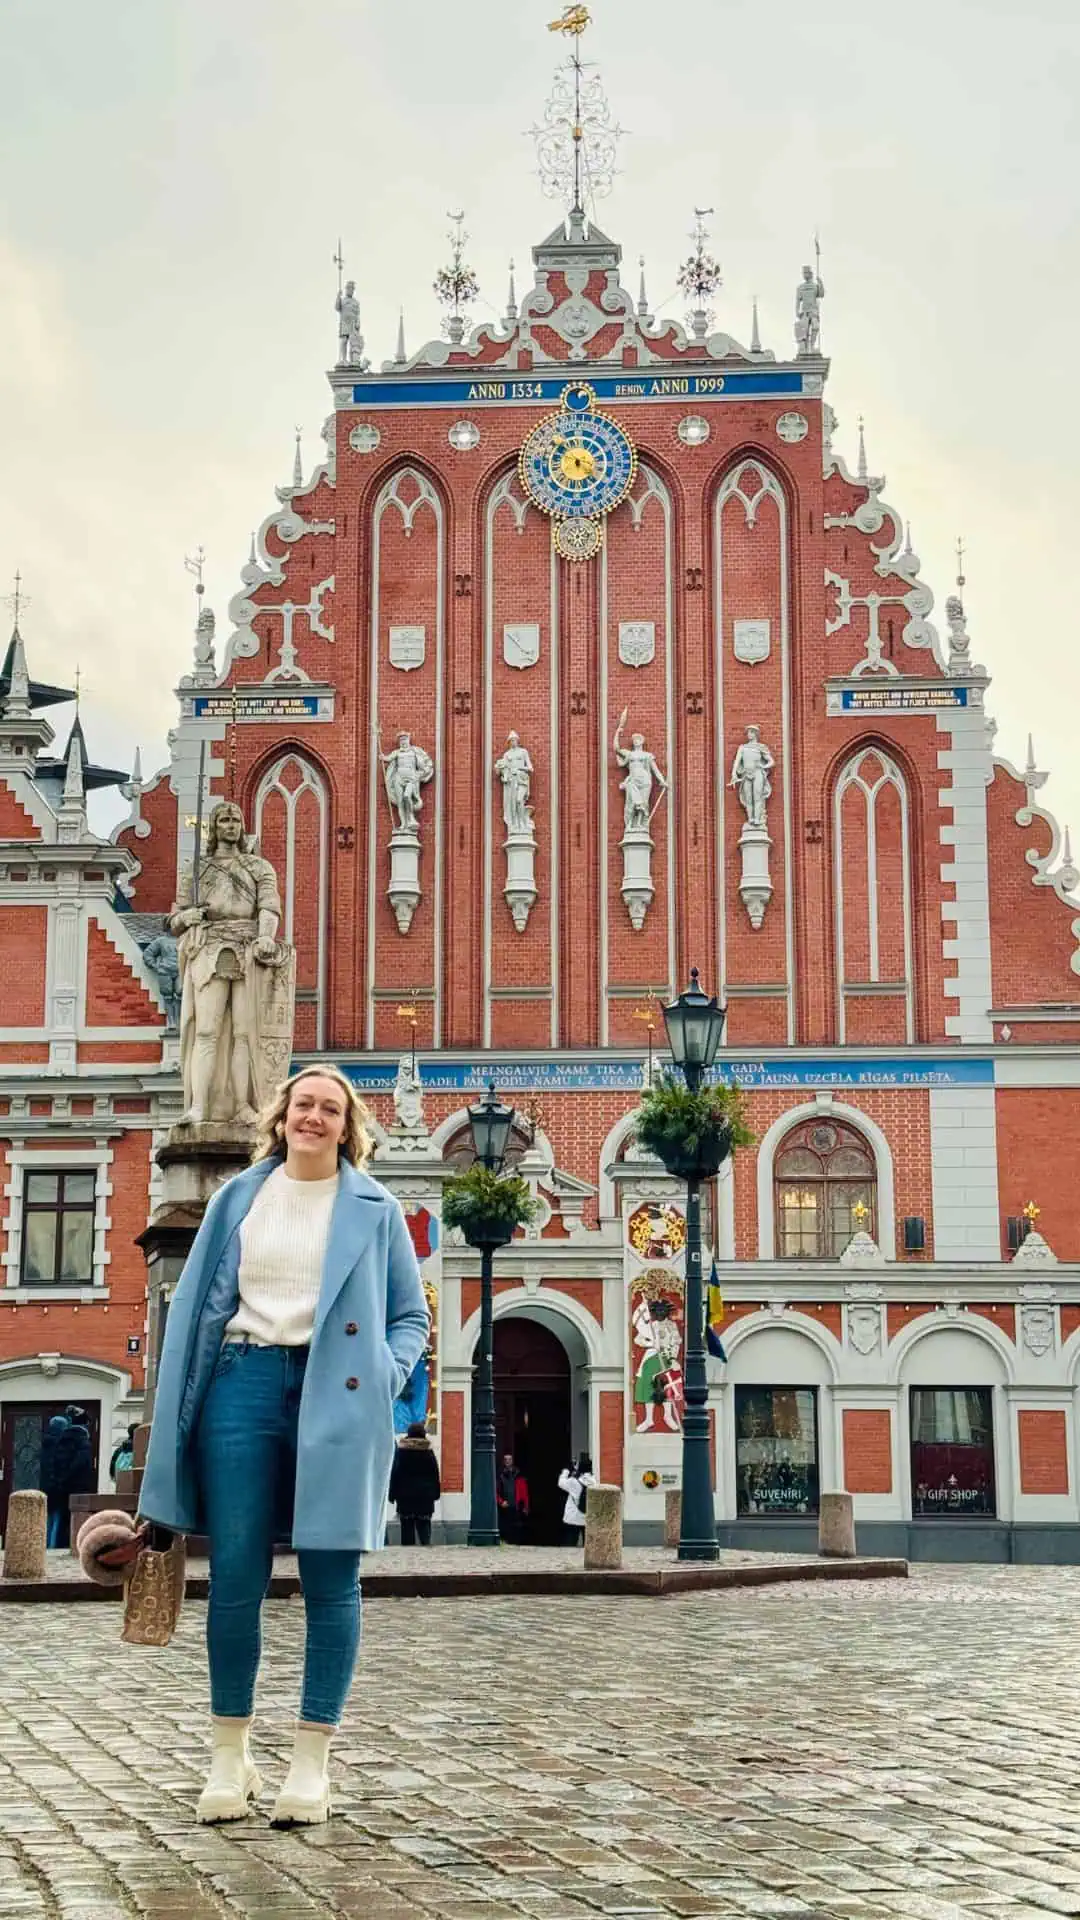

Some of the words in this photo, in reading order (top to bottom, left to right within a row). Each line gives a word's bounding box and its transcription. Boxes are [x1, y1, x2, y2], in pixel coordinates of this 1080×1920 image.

[468, 384, 505, 399] ANNO
[512, 384, 543, 398] 1334
[651, 380, 688, 395] ANNO
[695, 378, 725, 393] 1999
[555, 1064, 589, 1076] NAMS
[595, 1064, 624, 1075] TIKA
[463, 1076, 485, 1086] PAR
[491, 1075, 529, 1086] GODU
[534, 1075, 571, 1086] NAMU
[760, 1073, 800, 1085] JAUNA
[753, 1487, 802, 1500] SUVENĪRI
[928, 1488, 948, 1501] GIFT
[951, 1488, 978, 1500] SHOP
